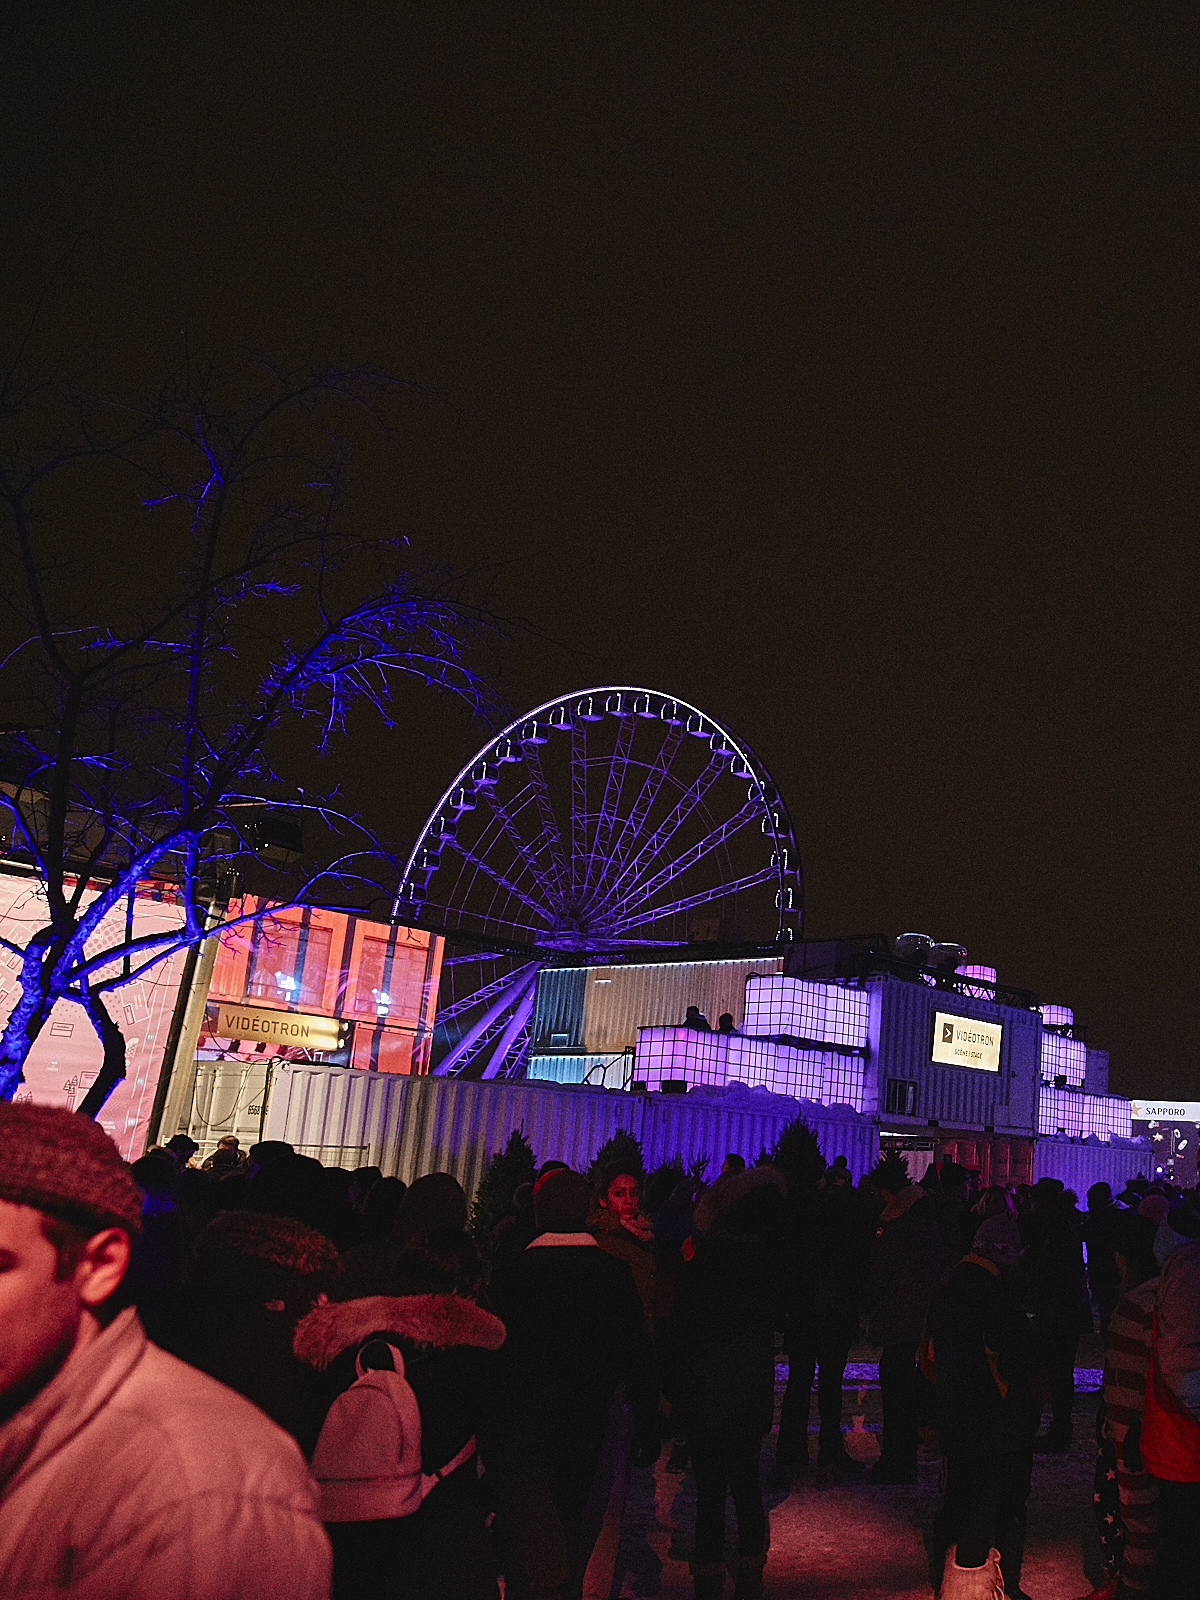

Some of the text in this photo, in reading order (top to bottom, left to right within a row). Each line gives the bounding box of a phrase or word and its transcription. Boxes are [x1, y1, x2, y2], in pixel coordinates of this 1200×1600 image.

[225, 1015, 310, 1038] VIDÉOTRON
[956, 1030, 994, 1046] VIDÉOTRON
[1146, 1107, 1186, 1116] SAPPORO
